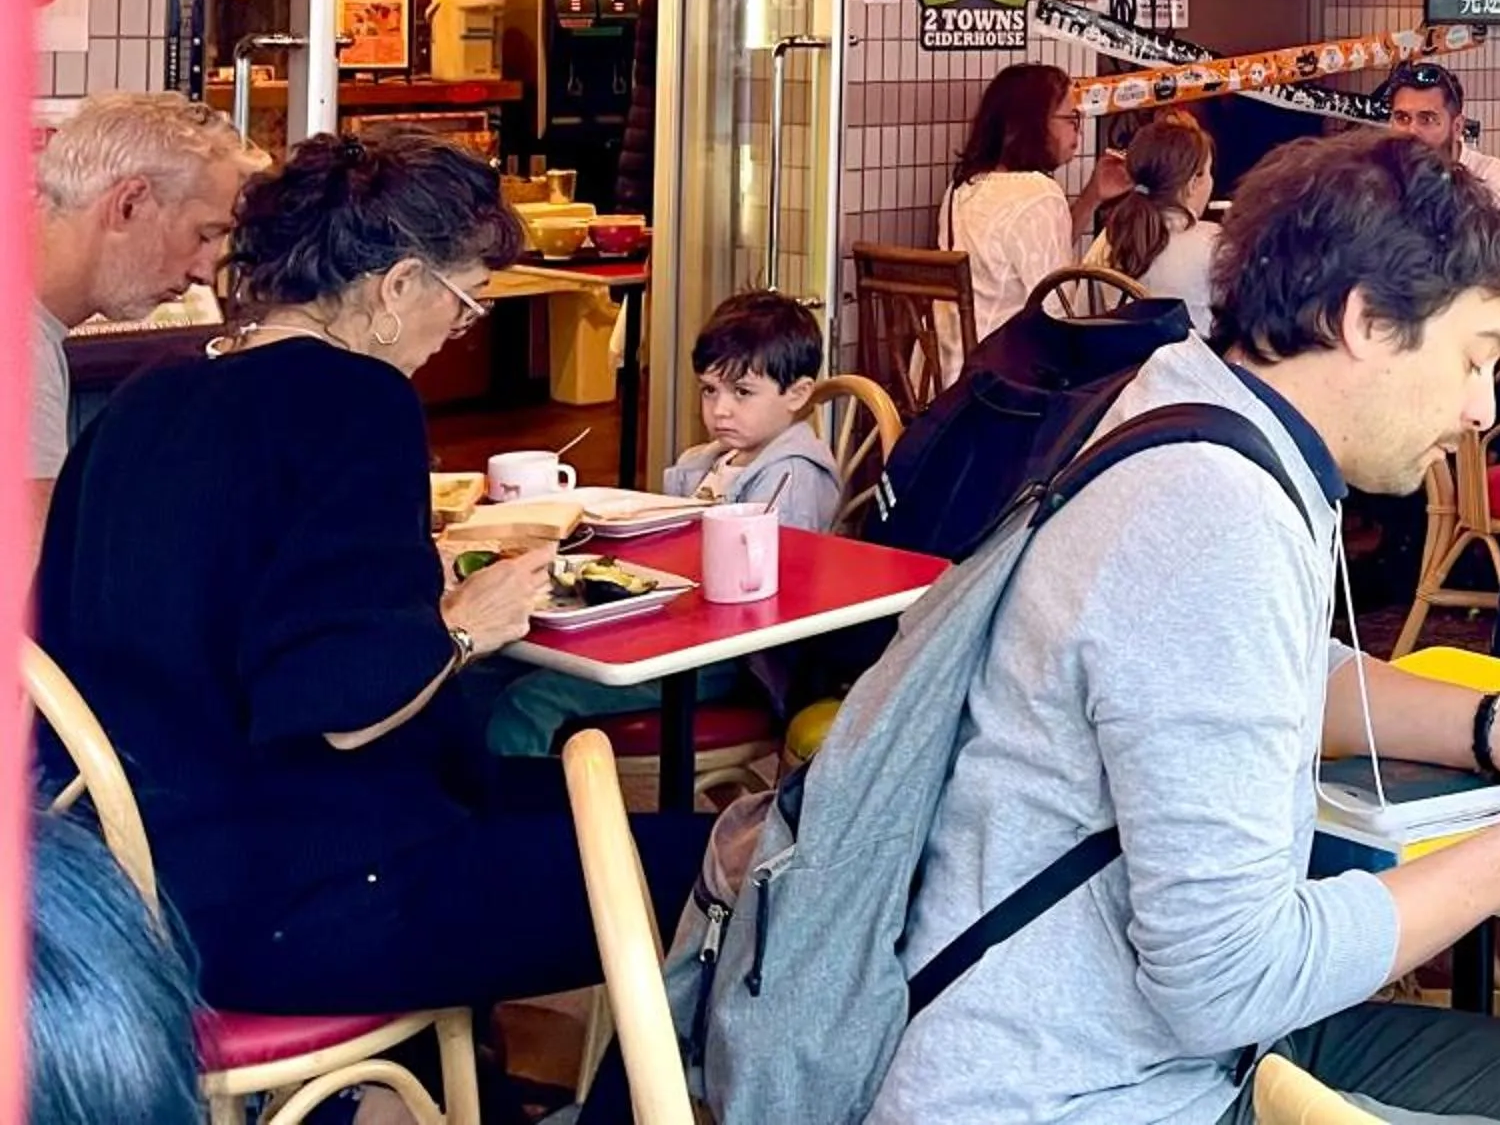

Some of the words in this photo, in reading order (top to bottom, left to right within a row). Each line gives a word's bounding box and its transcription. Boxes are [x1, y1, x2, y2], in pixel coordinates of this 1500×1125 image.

[924, 9, 938, 31] 2
[941, 8, 1025, 31] TOWNS
[923, 31, 1025, 46] CIDERHOUSE
